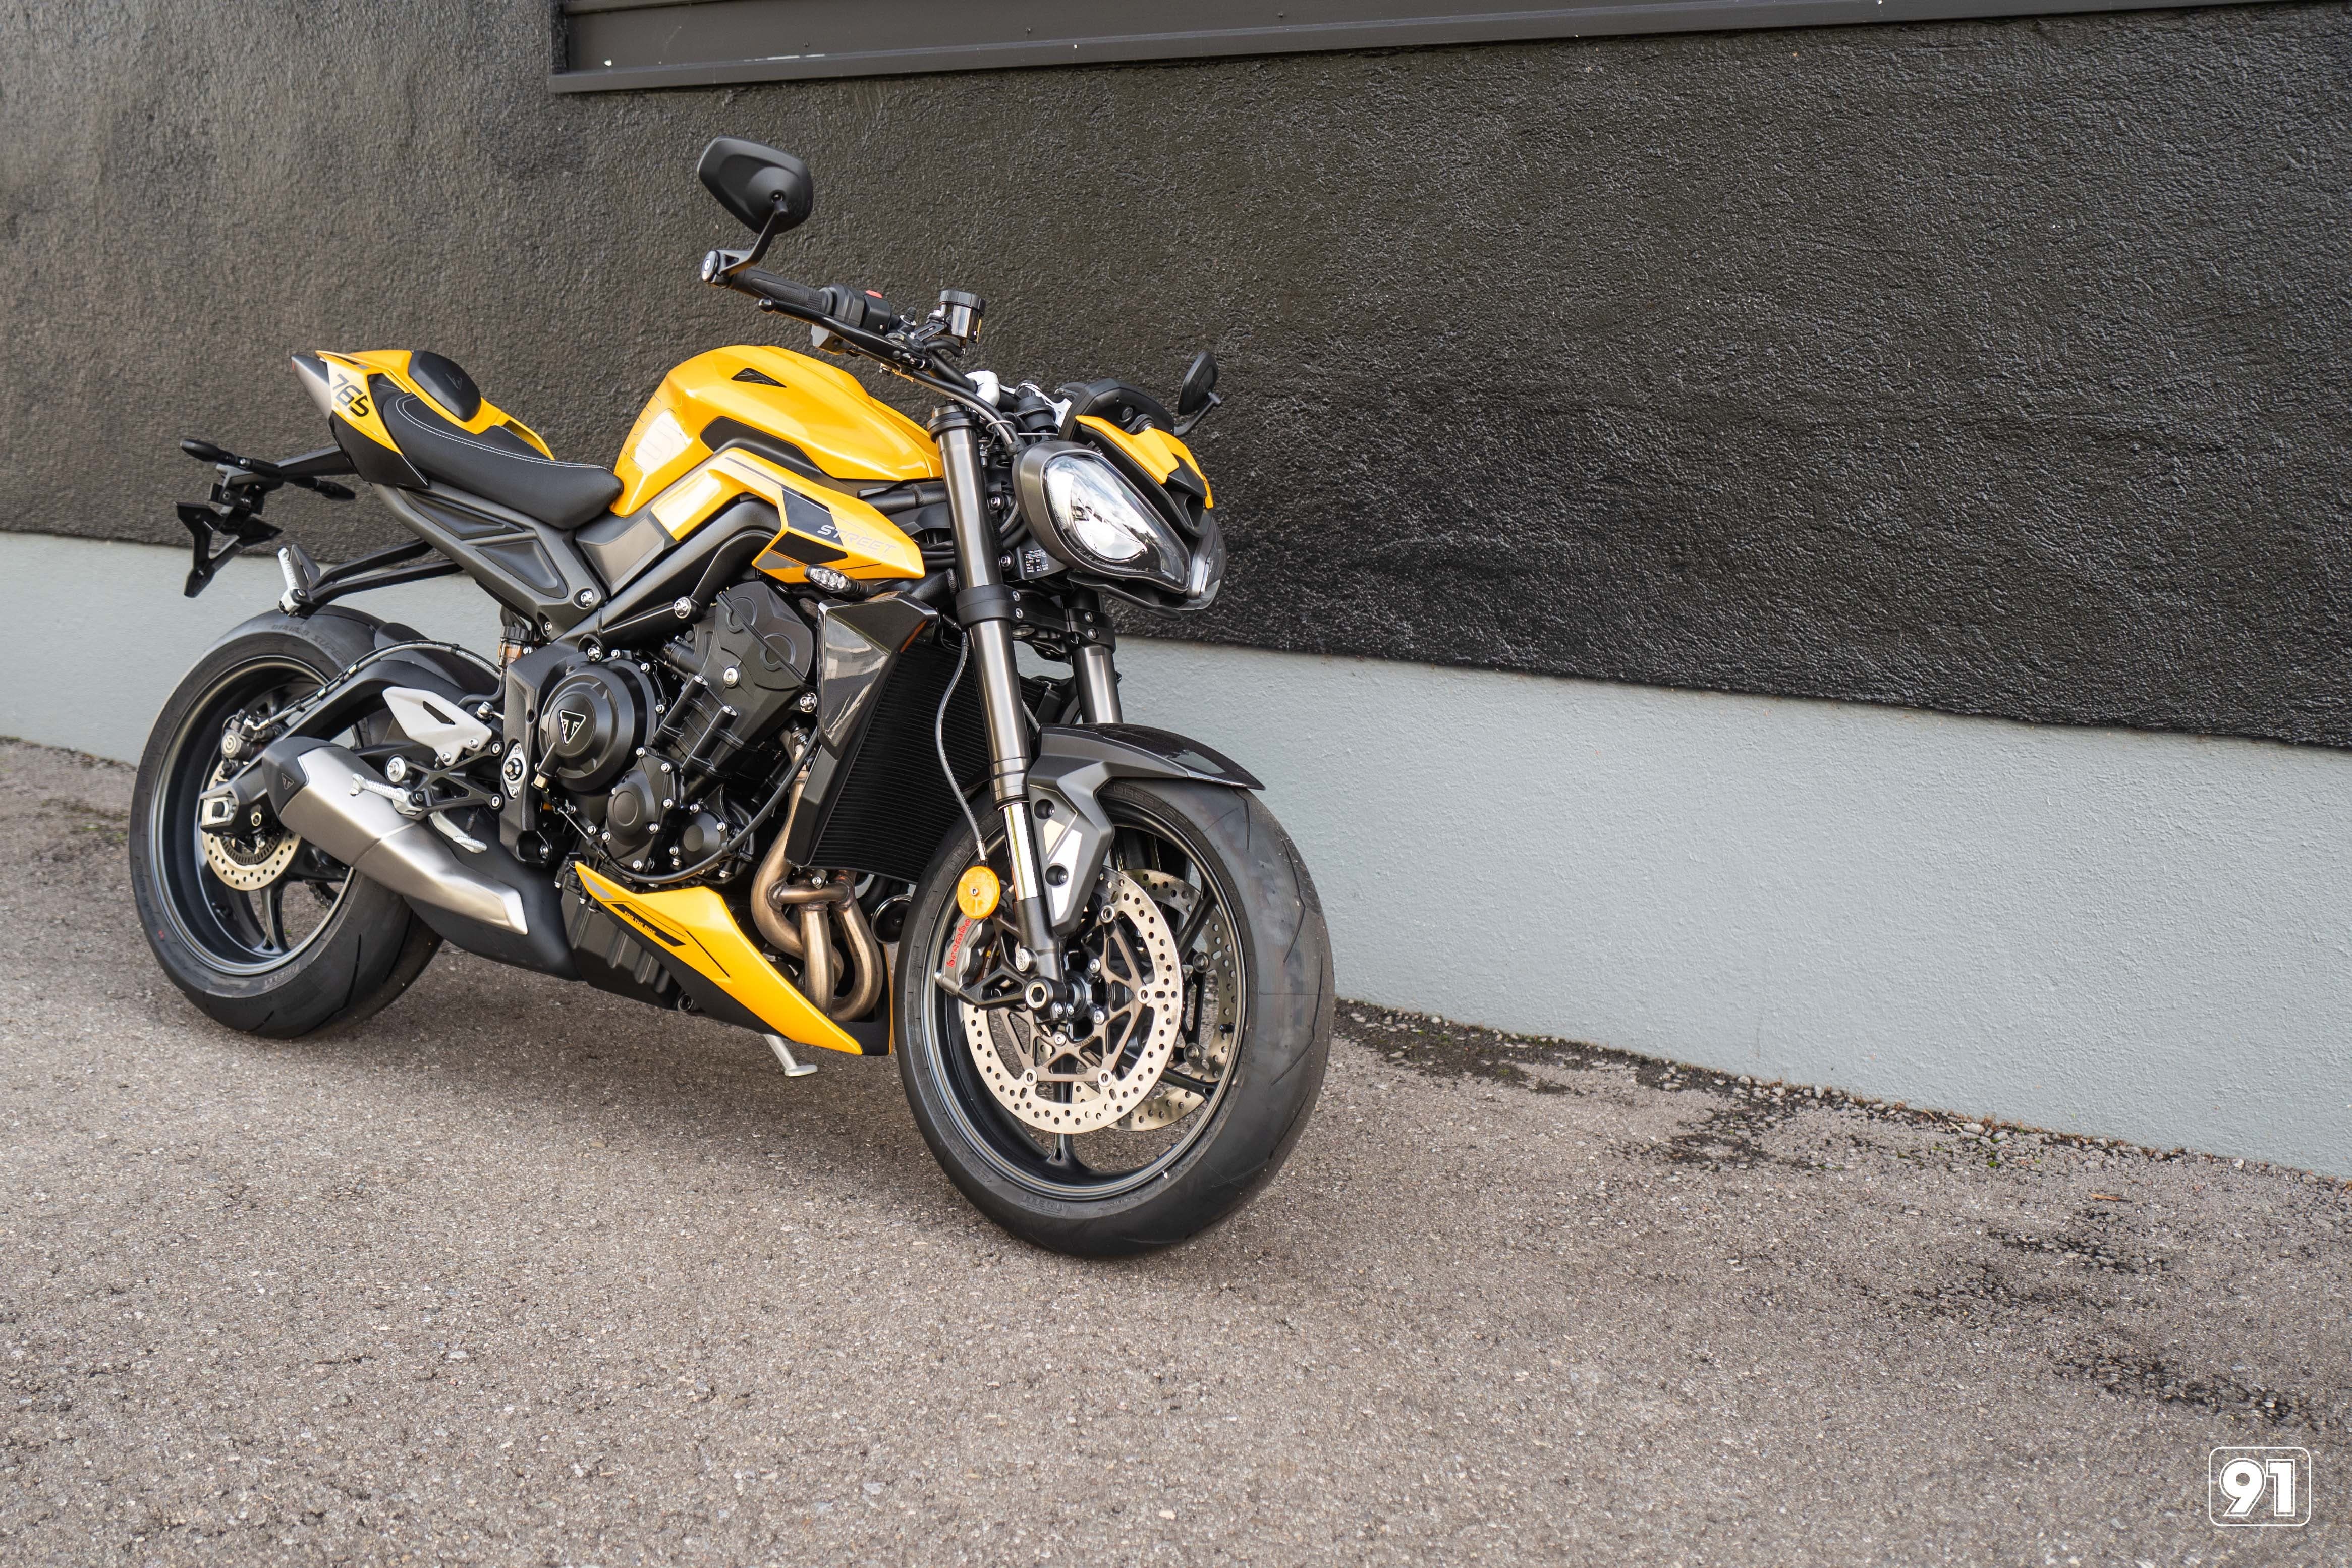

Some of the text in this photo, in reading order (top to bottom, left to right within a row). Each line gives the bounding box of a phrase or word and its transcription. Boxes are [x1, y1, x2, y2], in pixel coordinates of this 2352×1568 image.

[332, 373, 369, 417] 765
[817, 525, 897, 553] STREET
[624, 911, 634, 921] FOR
[644, 924, 657, 935] RIDE
[946, 919, 971, 968] brembo
